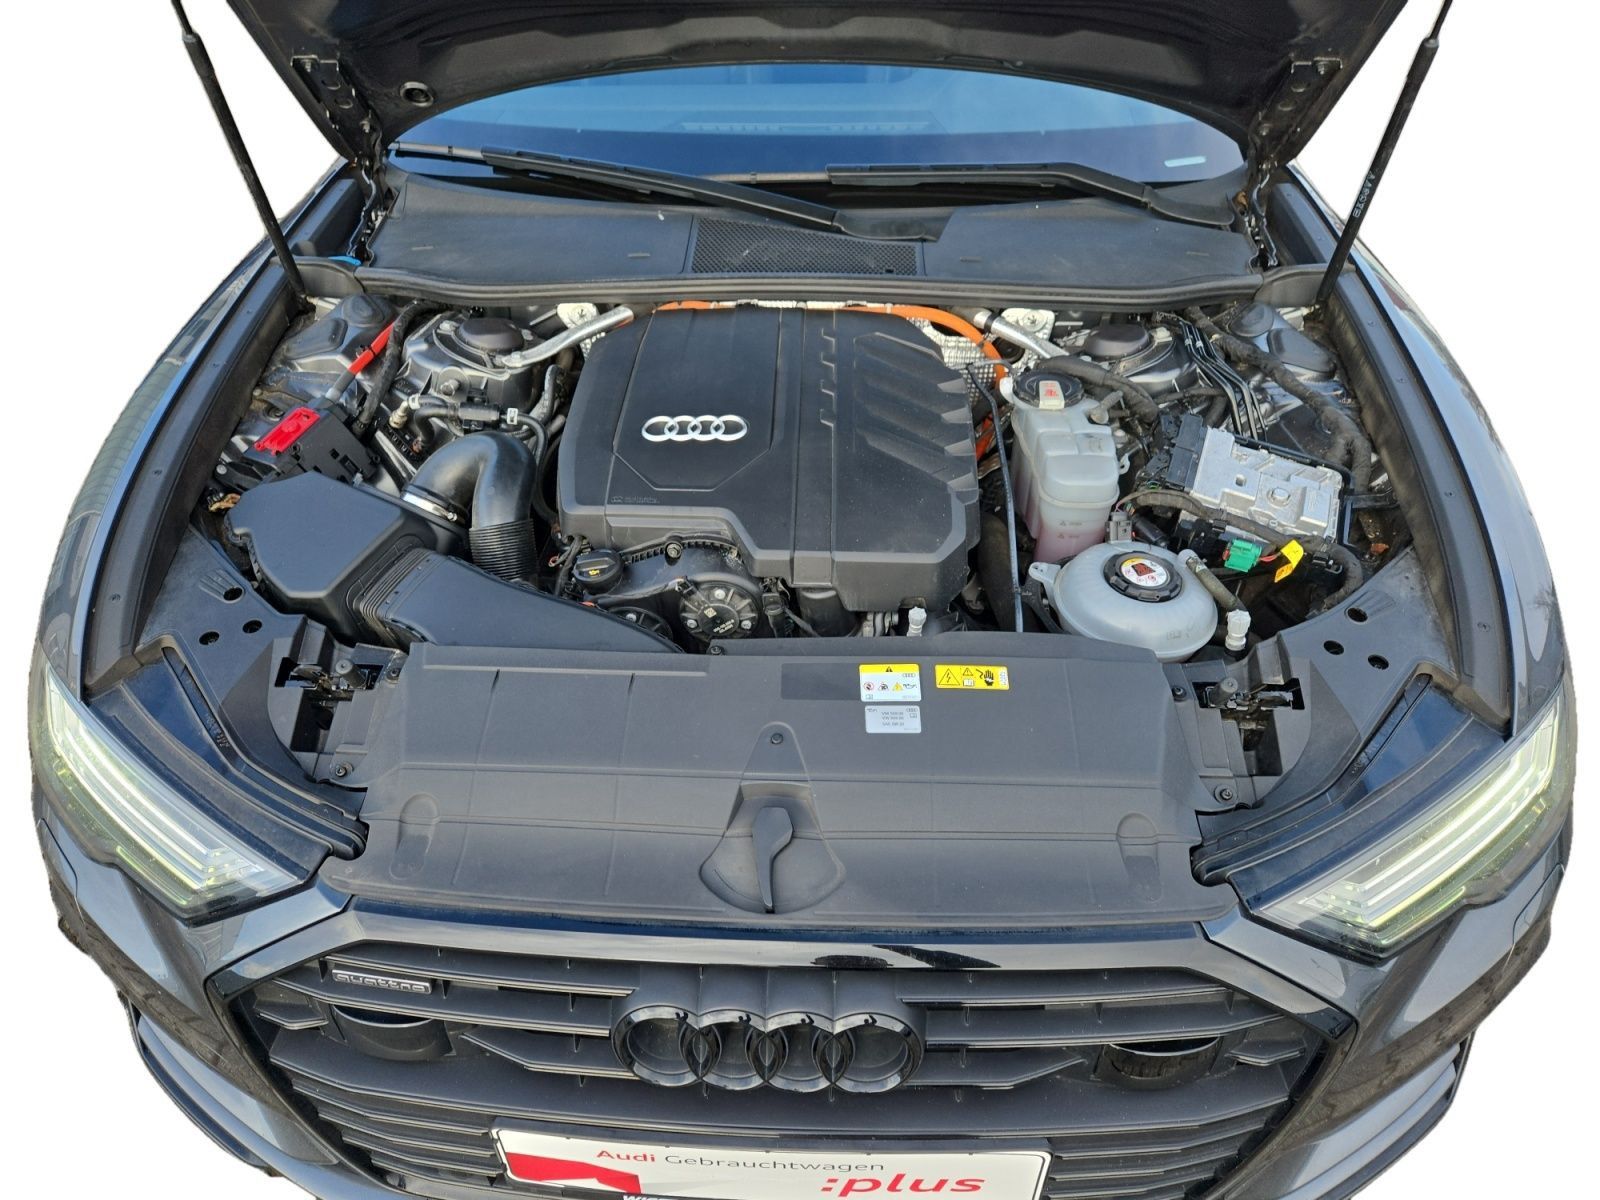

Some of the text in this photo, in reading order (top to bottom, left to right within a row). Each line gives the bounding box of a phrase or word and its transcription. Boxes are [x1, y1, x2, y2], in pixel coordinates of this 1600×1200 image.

[335, 973, 426, 992] quattro
[596, 1150, 884, 1172] Audi Gebrauchtwagen
[820, 1173, 985, 1197] :plus
